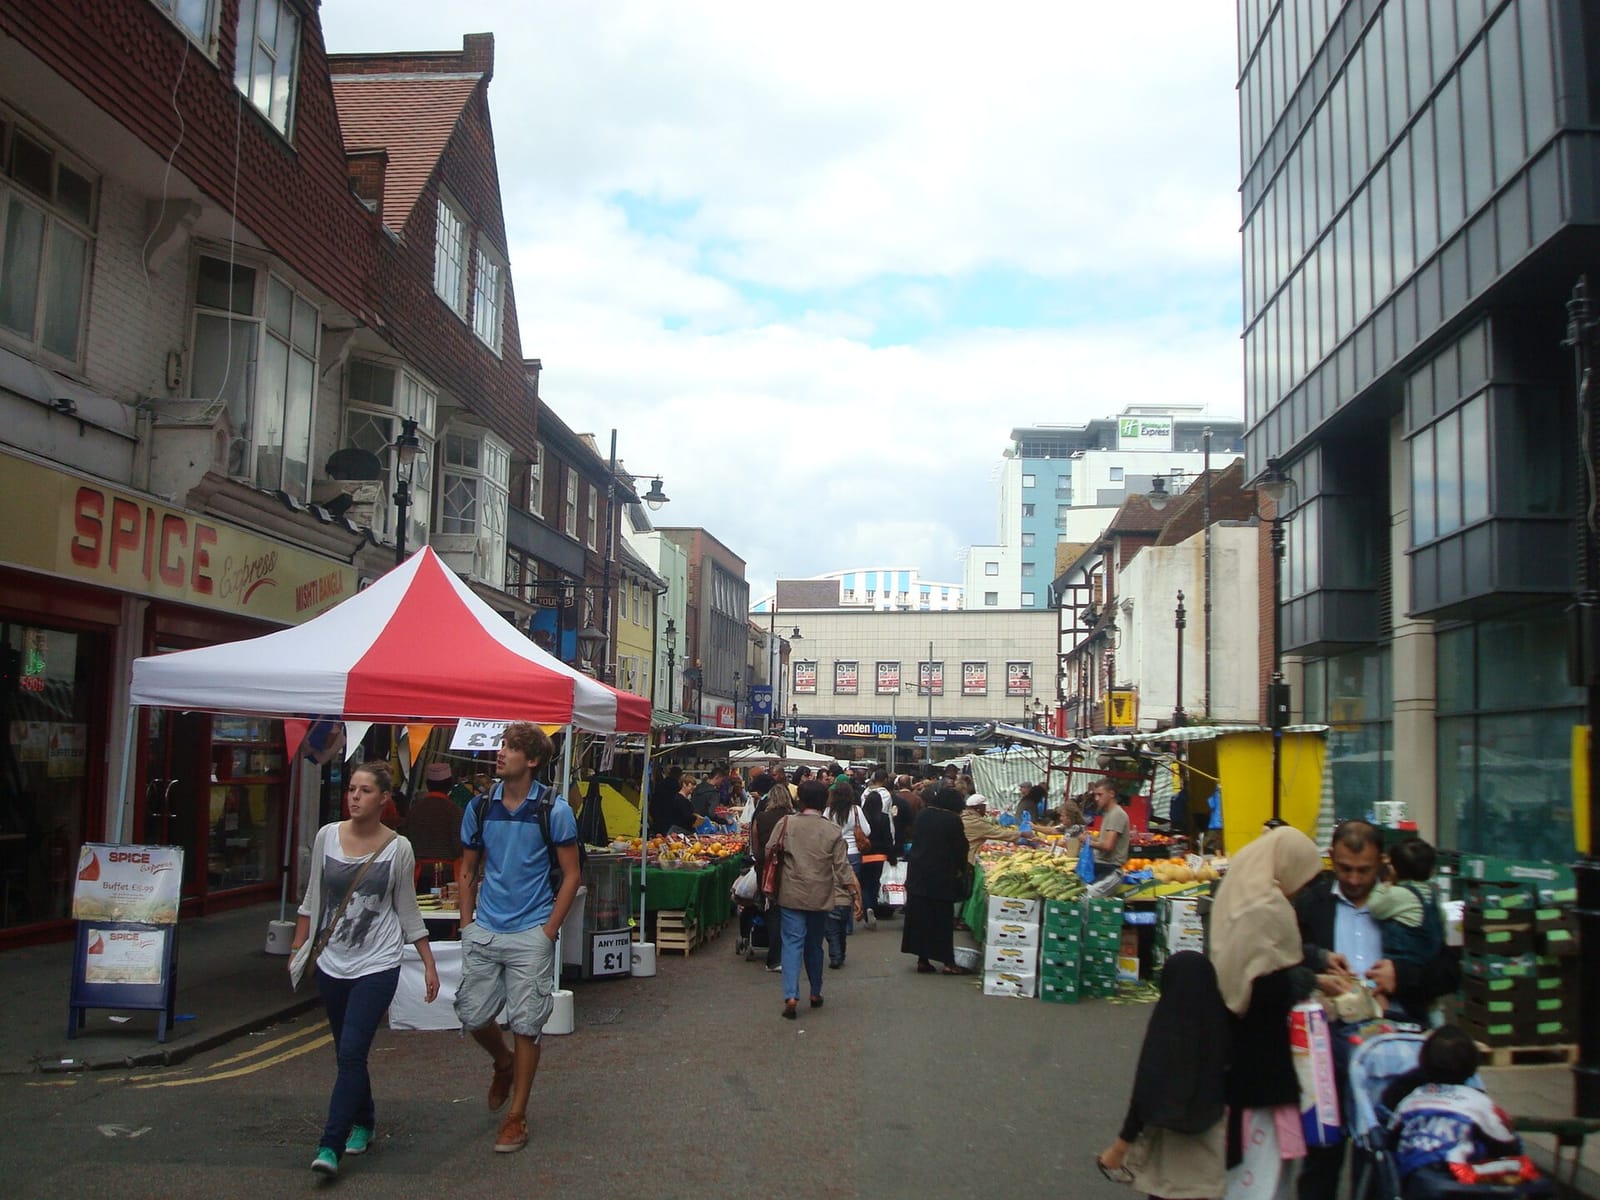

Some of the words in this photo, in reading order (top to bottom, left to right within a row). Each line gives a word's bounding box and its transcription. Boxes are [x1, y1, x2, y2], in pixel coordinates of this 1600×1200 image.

[1141, 427, 1169, 436] Express
[71, 486, 217, 595] SPICE
[219, 551, 279, 607] Express
[837, 722, 870, 735] ponden
[871, 722, 897, 733] home
[467, 733, 501, 747] £1
[109, 852, 150, 863] SPICE
[102, 882, 129, 890] Buffet
[110, 933, 139, 941] SPICE
[598, 940, 614, 948] ANY
[603, 952, 623, 970] £1
